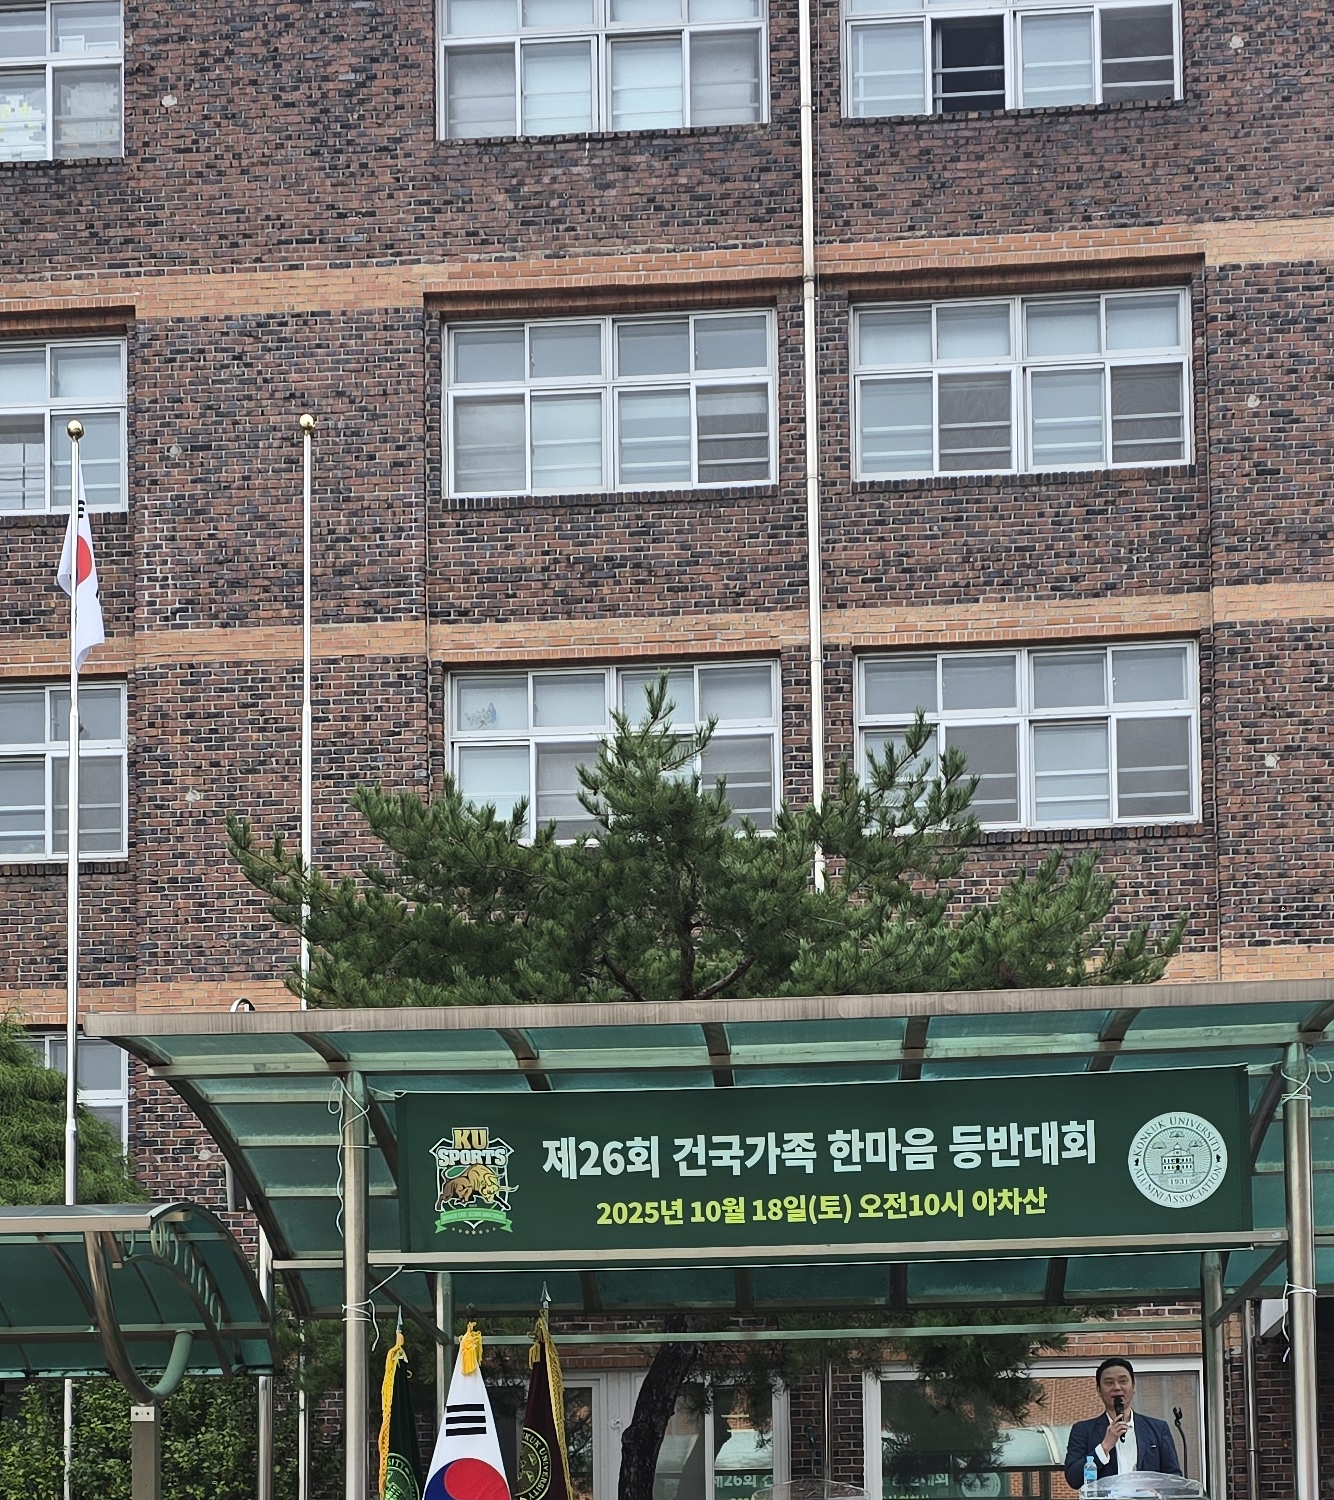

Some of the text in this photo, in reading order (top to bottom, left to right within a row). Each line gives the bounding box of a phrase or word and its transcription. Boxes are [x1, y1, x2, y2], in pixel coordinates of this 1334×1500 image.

[453, 1129, 488, 1149] KU
[542, 1119, 1096, 1180] 제26회 건국가족 한마음 등반대회
[1133, 1116, 1221, 1157] KONKUK UNIVERSITY
[437, 1148, 507, 1167] SPORTS
[1134, 1167, 1223, 1204] ALUMNI ASSOCIATION
[1170, 1178, 1189, 1186] 1931
[596, 1186, 1048, 1226] 2025년 10월 18일(토) 오전10시 아차산
